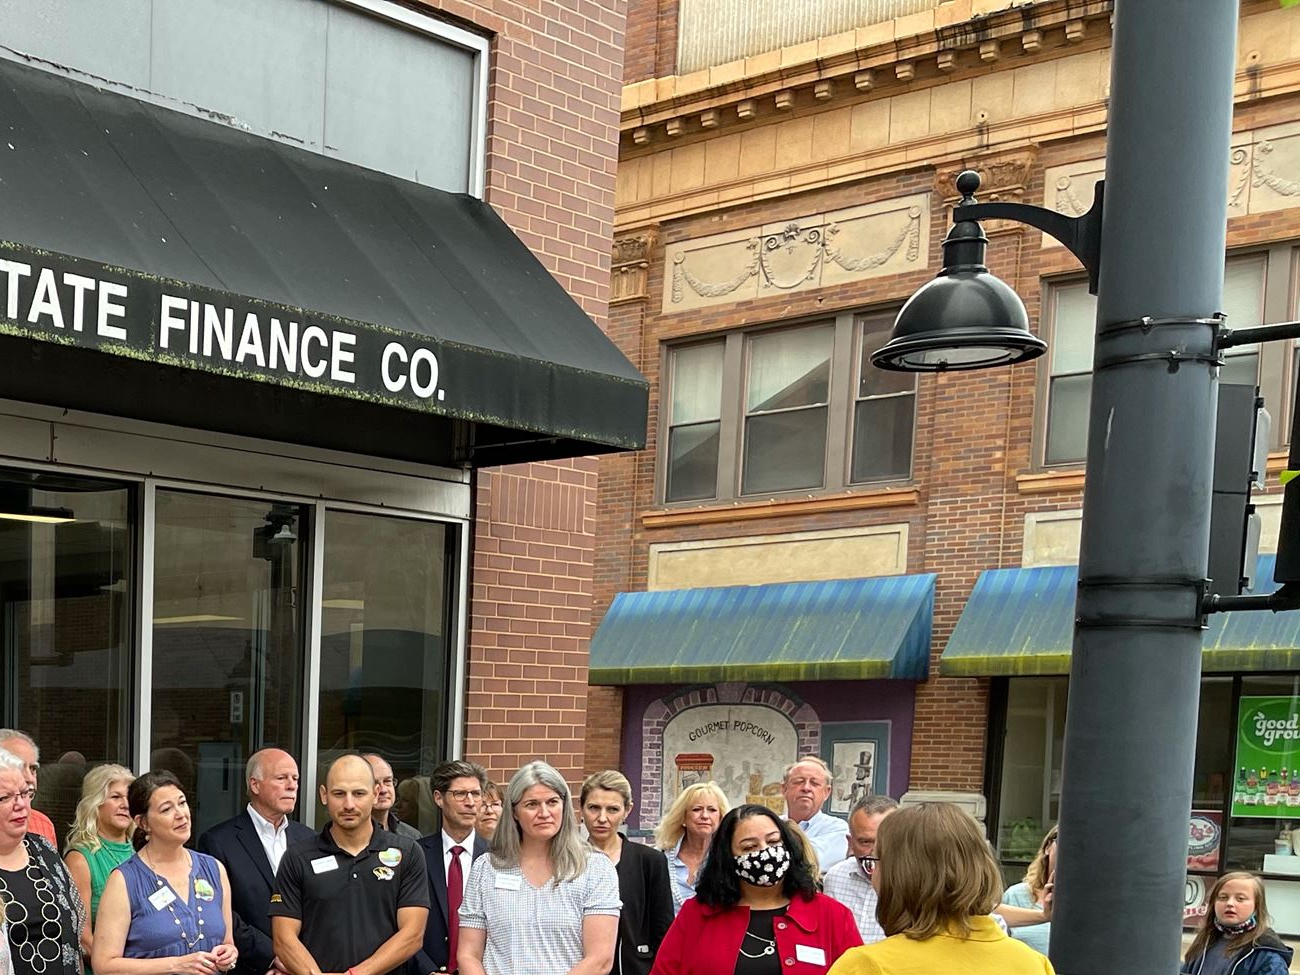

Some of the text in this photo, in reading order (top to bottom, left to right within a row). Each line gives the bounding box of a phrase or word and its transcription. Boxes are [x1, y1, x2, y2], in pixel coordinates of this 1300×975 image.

[159, 294, 357, 384] FINANCE
[381, 342, 446, 401] CO.
[688, 720, 776, 745] GOURMET POPCORN
[1255, 713, 1299, 737] good
